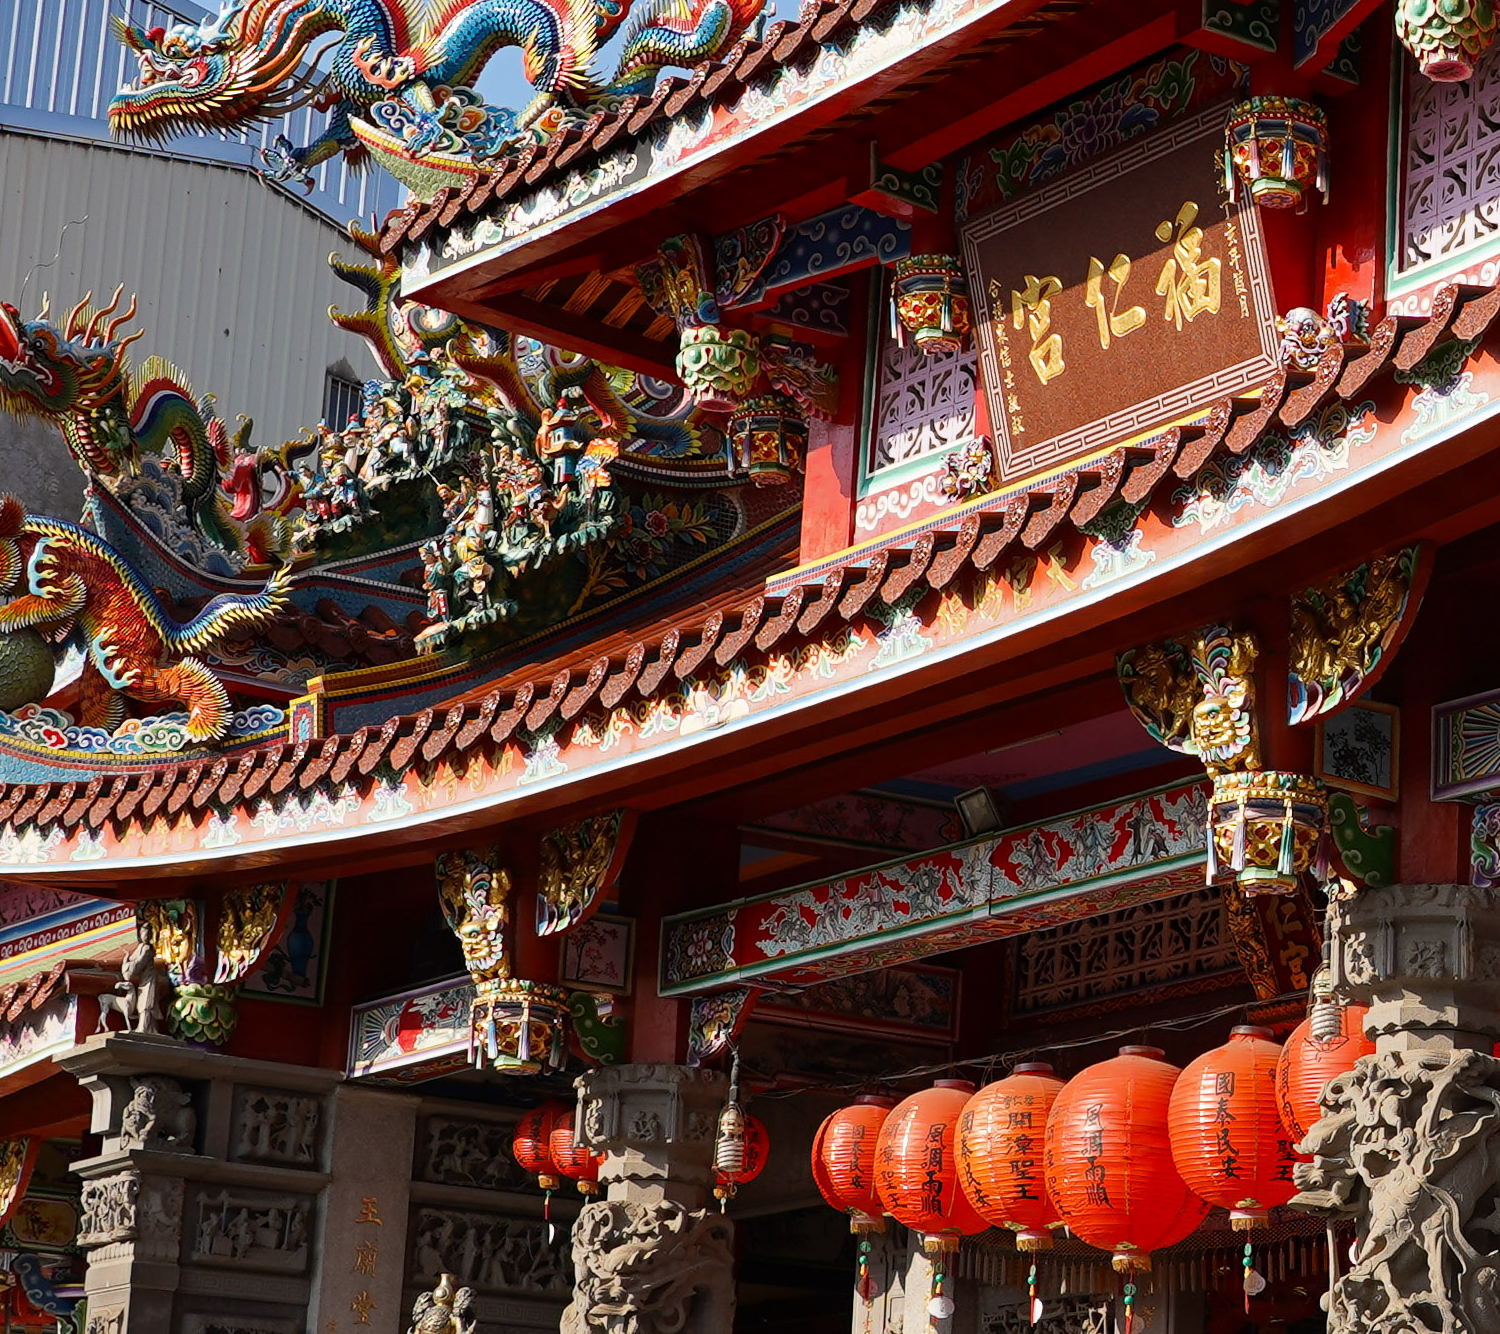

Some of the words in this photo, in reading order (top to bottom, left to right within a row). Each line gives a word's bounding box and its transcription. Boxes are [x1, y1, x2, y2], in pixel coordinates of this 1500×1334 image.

[1011, 200, 1222, 386] 福仁宮
[921, 1123, 947, 1217] 風調雨順
[960, 1110, 993, 1208] 國泰民安
[1005, 1112, 1039, 1201] 開漳聖王
[1082, 1103, 1115, 1210] 風調雨順
[1213, 1071, 1244, 1180] 國泰民安
